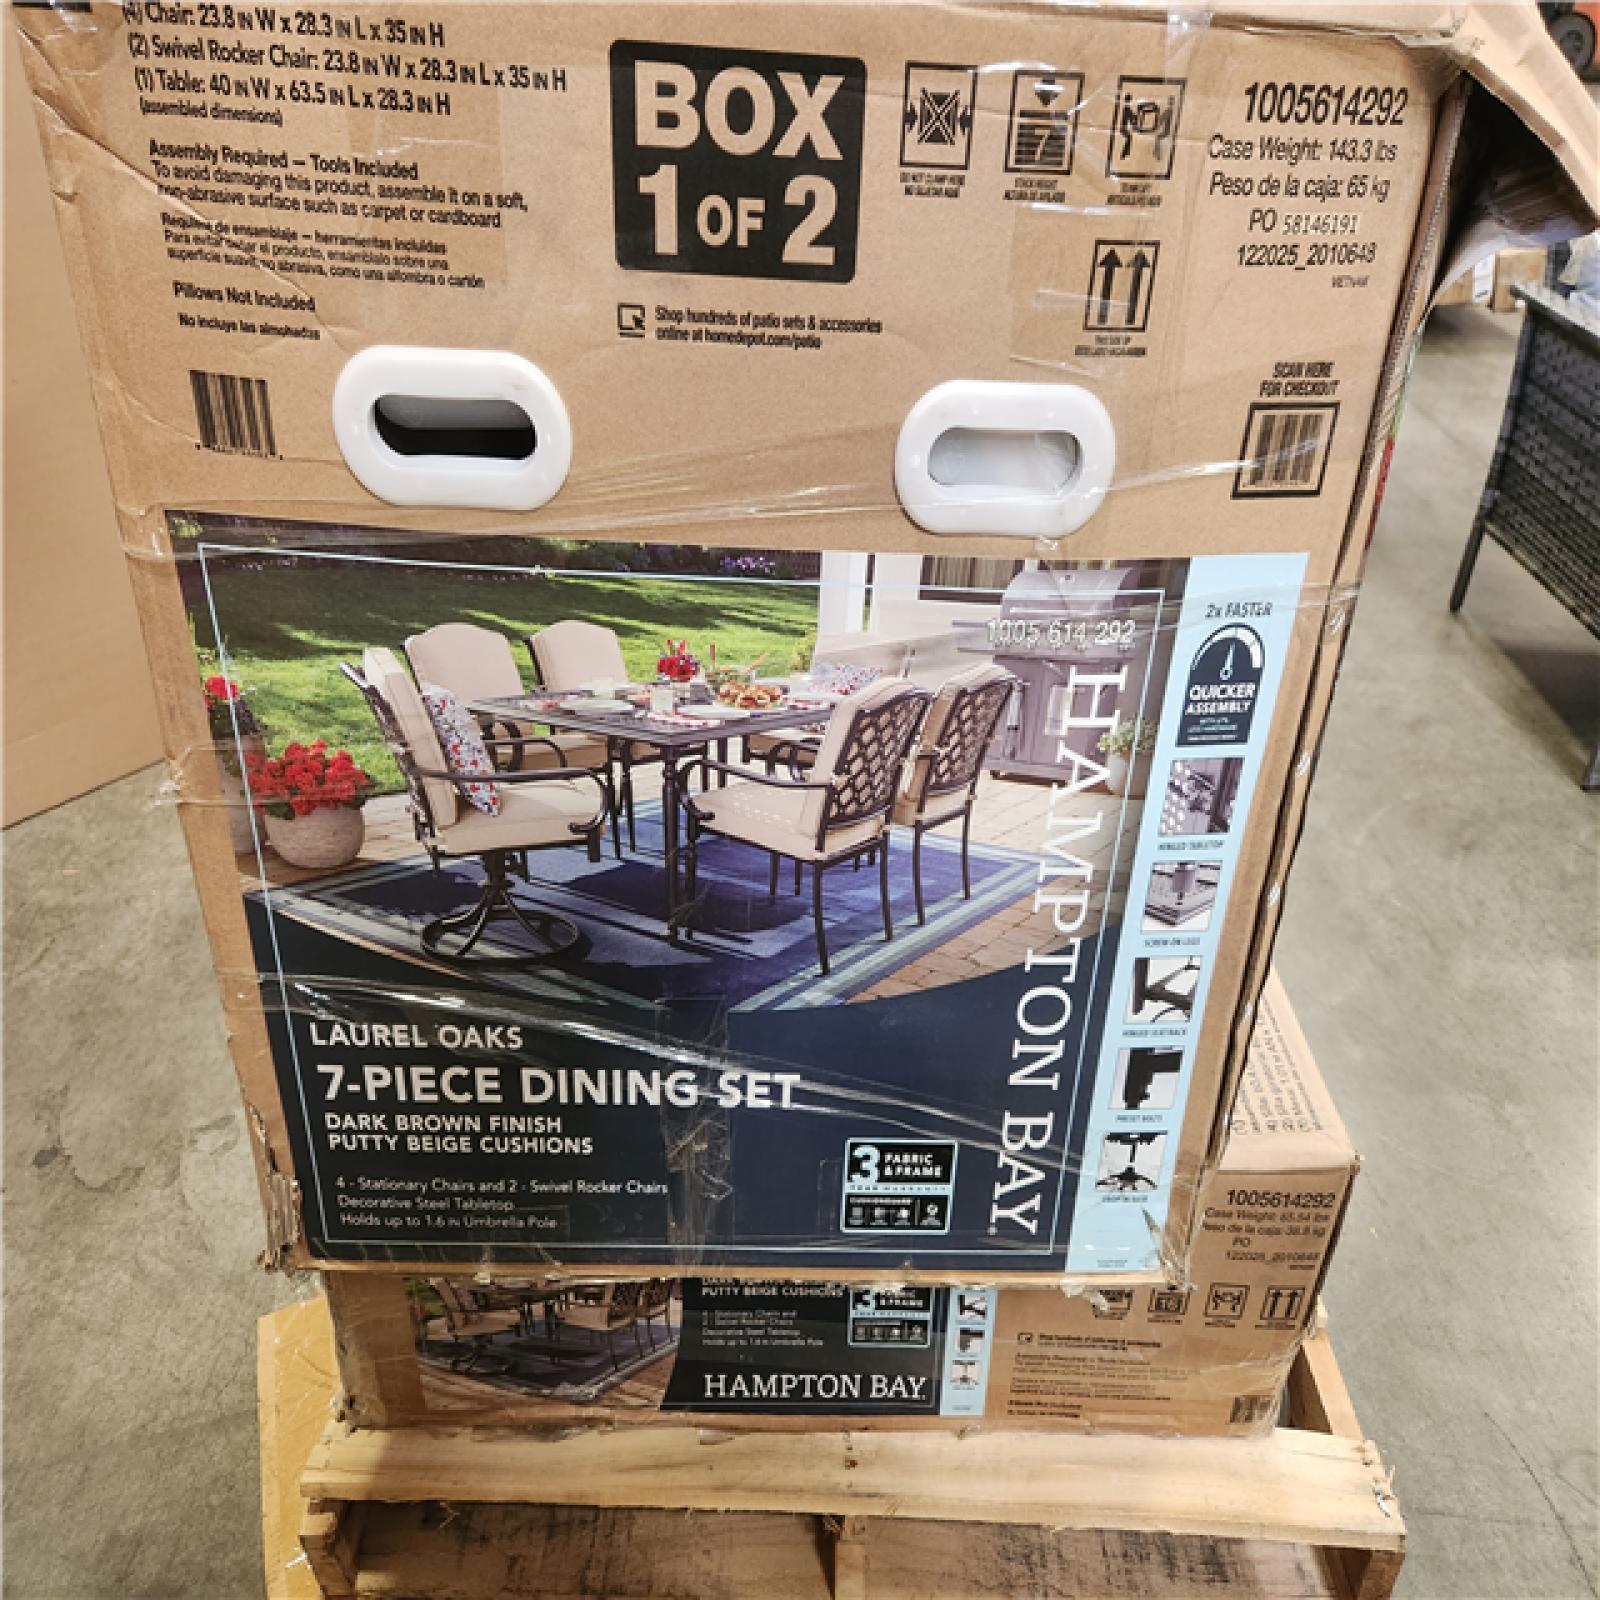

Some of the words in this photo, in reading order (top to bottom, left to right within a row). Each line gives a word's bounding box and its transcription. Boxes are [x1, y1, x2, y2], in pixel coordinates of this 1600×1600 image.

[144, 1, 195, 26] Chair:
[197, 3, 235, 28] 23.8
[254, 7, 275, 31] W
[295, 10, 333, 36] 28.3
[385, 17, 406, 43] 35
[429, 22, 445, 47] H
[128, 32, 149, 58] (2)
[151, 34, 205, 60] Swivel
[207, 39, 265, 65] Rocker
[269, 44, 319, 70] Chair:
[322, 49, 360, 73] 23.8
[380, 54, 400, 77] W
[420, 57, 457, 83] 28.3
[509, 65, 530, 88] 35
[552, 67, 566, 92] H
[135, 66, 154, 93] (1)
[155, 69, 205, 93] Table:
[209, 73, 230, 95] 40
[250, 77, 271, 99] W
[289, 80, 326, 103] 63.5
[377, 87, 414, 112] 28.3
[434, 92, 451, 115] H
[1244, 82, 1409, 126] 1005614292
[633, 60, 846, 161] BOX
[1033, 127, 1050, 162] 7
[1209, 132, 1253, 160] Case
[1259, 135, 1323, 166] Weight:
[1329, 137, 1373, 163] 143.3
[1375, 139, 1399, 162] lbs
[150, 138, 218, 165] Assembly
[221, 145, 288, 168] Required
[309, 154, 350, 173] Tools
[353, 157, 419, 181] Included
[151, 160, 170, 178] To
[173, 165, 210, 181] avoid
[212, 168, 283, 192] damaging
[285, 174, 311, 191] this
[315, 178, 375, 198] product,
[377, 185, 446, 204] assemble
[462, 191, 480, 206] on
[483, 193, 493, 207] a
[497, 192, 528, 212] soft,
[1209, 170, 1253, 196] Peso
[1257, 172, 1281, 196] de
[1284, 173, 1300, 196] la
[1304, 174, 1344, 203] caja:
[1347, 174, 1369, 199] 65
[1370, 174, 1391, 203] kg
[247, 193, 301, 211] surface
[304, 198, 337, 214] such
[340, 202, 358, 216] as
[361, 204, 406, 223] carpet
[409, 208, 425, 221] or
[427, 209, 502, 229] cardboard
[637, 164, 679, 256] 1
[696, 194, 766, 248] OF
[781, 174, 838, 266] 2
[1249, 207, 1278, 233] PO
[1281, 213, 1359, 236] 58146191
[164, 229, 191, 245] Para
[393, 237, 447, 255] incluidas
[172, 280, 223, 301] Pillows
[225, 287, 253, 306] Not
[255, 290, 316, 313] Included
[178, 312, 196, 327] No
[654, 304, 684, 325] Shop
[686, 307, 738, 328] hundreds
[739, 311, 751, 327] of
[752, 312, 781, 331] patio
[782, 315, 806, 331] sets
[807, 314, 816, 331] &
[819, 317, 883, 334] accessories
[655, 325, 689, 341] online
[704, 328, 823, 351] homedepot.com/patio
[1272, 361, 1304, 378] SCAN
[1305, 361, 1335, 378] HERE
[1260, 379, 1281, 398] FOR
[1283, 379, 1341, 398] CHECKOUT
[1225, 601, 1273, 618] FASTER
[984, 618, 1041, 646] 1005
[1048, 618, 1087, 646] 614
[1094, 618, 1137, 647] 292
[1189, 682, 1257, 701] QUICKER
[1185, 699, 1253, 716] ASSEMBLY
[1007, 664, 1129, 1092] HAMPTON
[309, 1021, 429, 1047] LAUREL
[438, 1024, 525, 1049] OAKS
[316, 1064, 504, 1104] 7-PIECE
[520, 1066, 699, 1108] DINING
[717, 1072, 801, 1109] SET
[324, 1111, 389, 1131] DARK
[395, 1113, 481, 1133] BROWN
[489, 1115, 562, 1134] FINISH
[328, 1134, 399, 1152] PUTTY
[406, 1134, 474, 1154] BEIGE
[480, 1136, 594, 1155] CUSHIONS
[848, 1145, 880, 1184] 3
[884, 1152, 934, 1166] FABRIC
[895, 1165, 942, 1179] FRAME
[988, 1109, 1055, 1236] BAY
[335, 1176, 345, 1189] 4
[357, 1176, 427, 1195] Stationary
[432, 1177, 476, 1192] Chairs
[479, 1179, 505, 1193] and
[509, 1179, 518, 1193] 2
[530, 1179, 573, 1194] Swivel
[577, 1179, 622, 1194] Rocker
[626, 1179, 668, 1195] Chairs
[1227, 1189, 1336, 1209] 1005614292
[337, 1194, 412, 1209] Decorative
[415, 1196, 451, 1210] Steel
[453, 1197, 515, 1213] Tabletop
[340, 1211, 381, 1226] Holds
[385, 1215, 403, 1228] up
[405, 1214, 421, 1227] to
[464, 1216, 525, 1229] Umbrella
[527, 1216, 557, 1229] Pole
[1232, 1236, 1251, 1248] PO
[702, 1286, 741, 1297] PUTTY
[703, 1374, 862, 1399] HAMPTON
[869, 1374, 927, 1400] BAY
